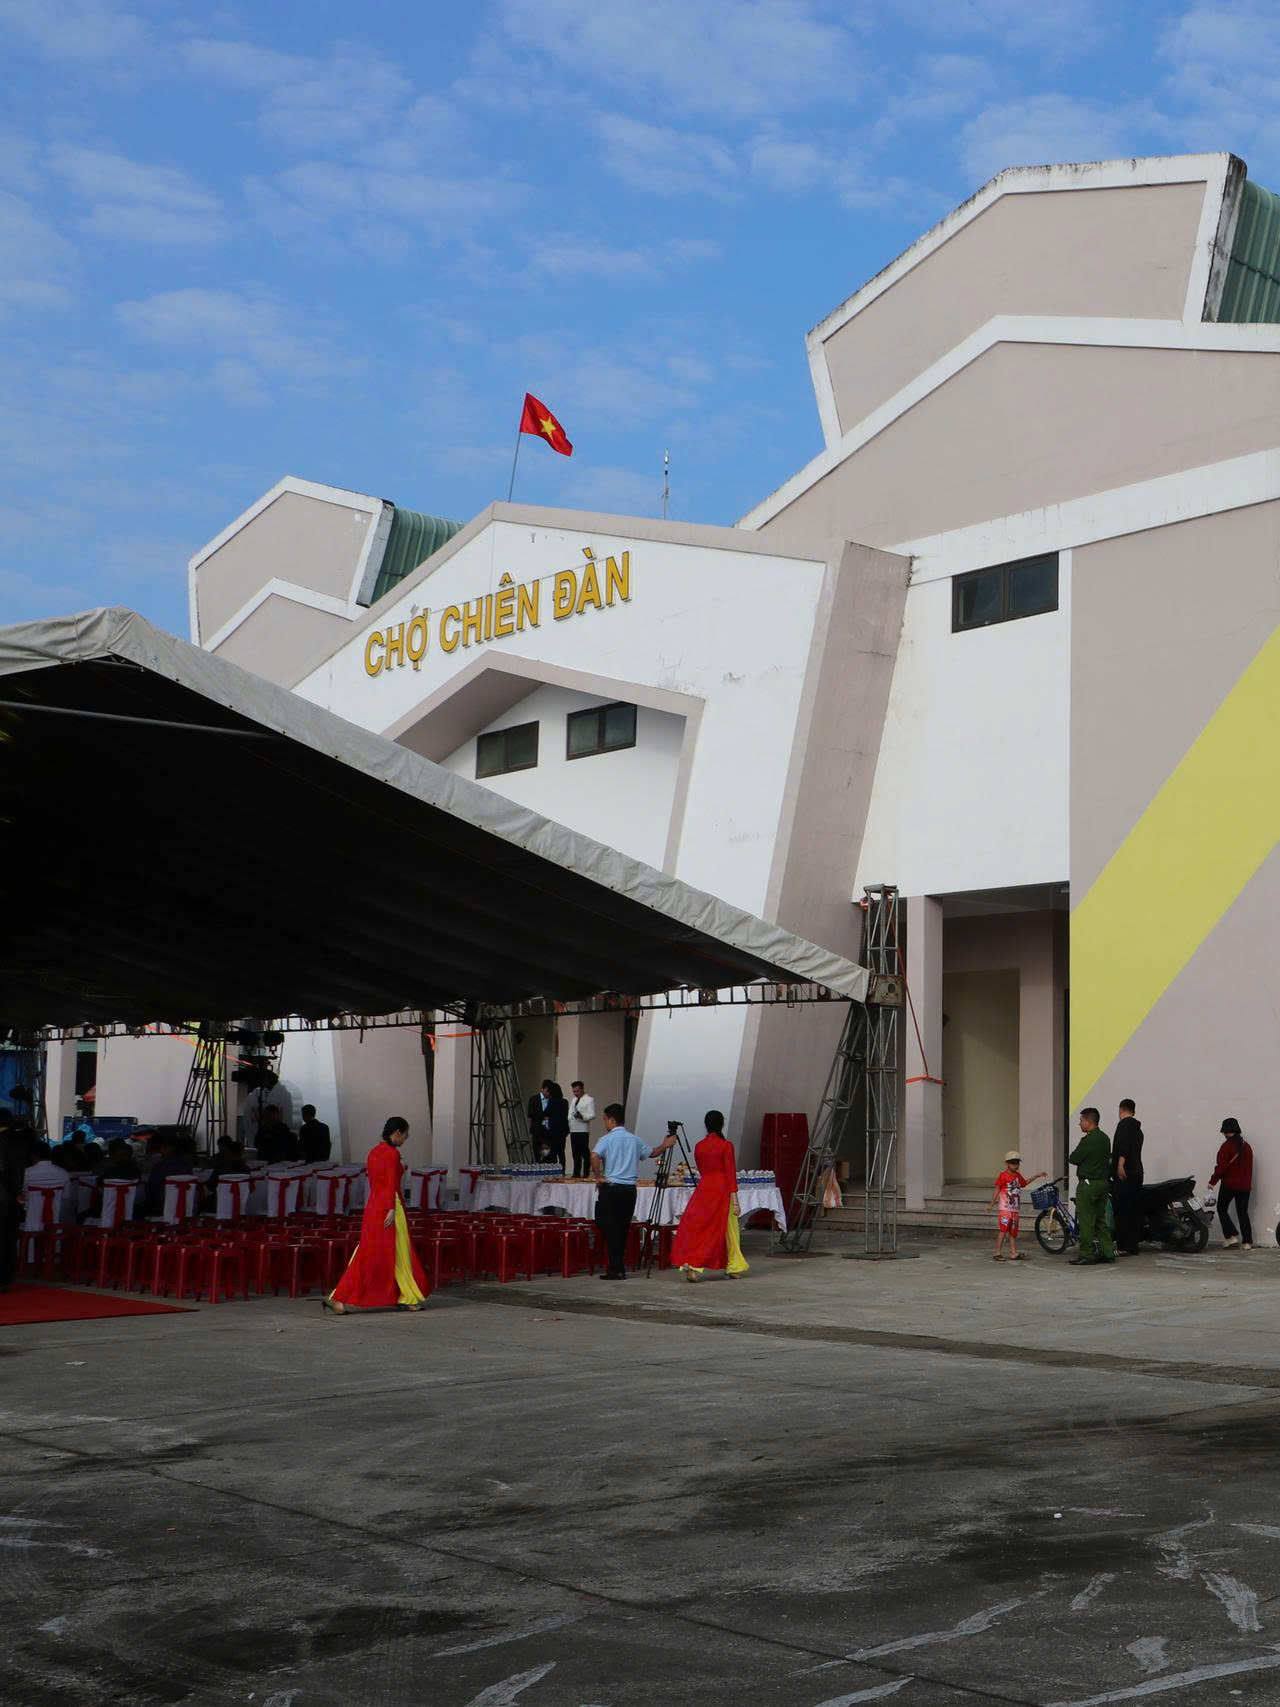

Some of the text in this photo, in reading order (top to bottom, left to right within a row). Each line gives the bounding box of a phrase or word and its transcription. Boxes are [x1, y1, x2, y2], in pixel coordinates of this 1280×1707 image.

[364, 547, 631, 677] CHỢ CHIÊN ĐÀN
